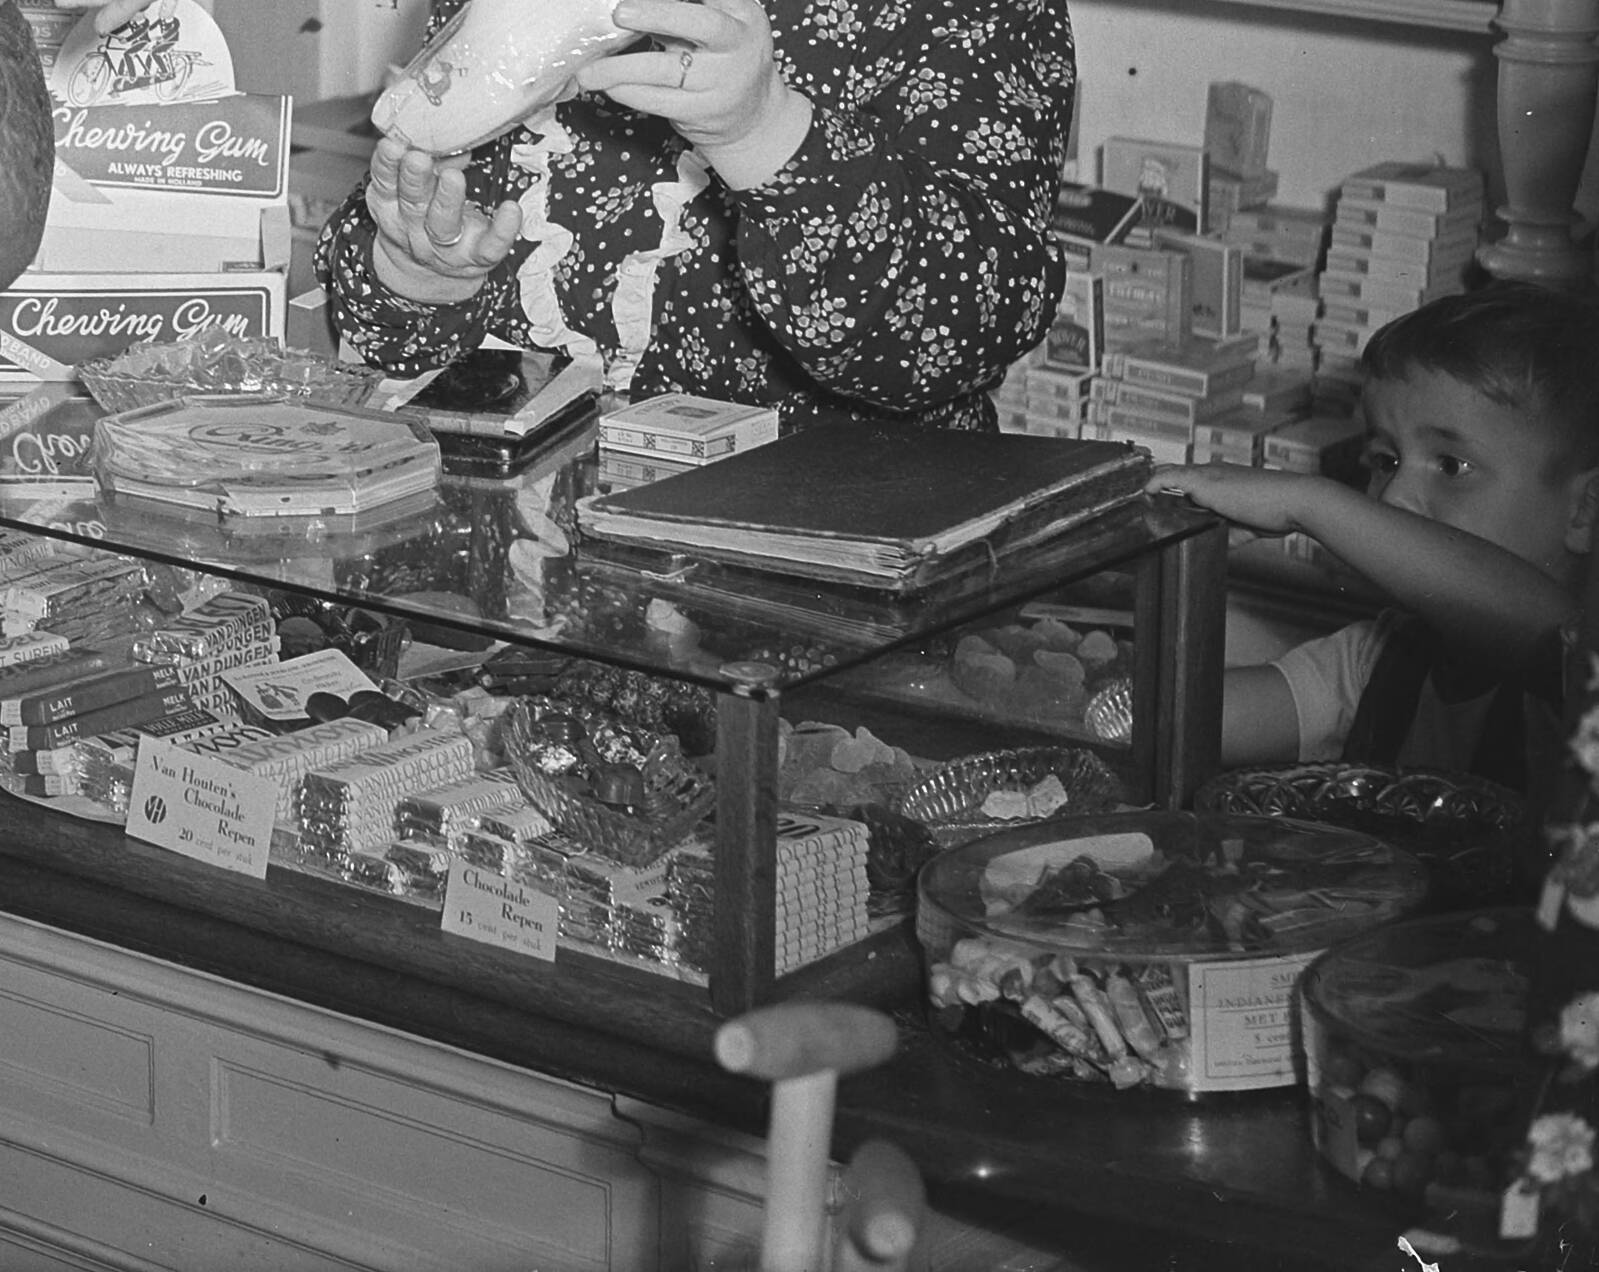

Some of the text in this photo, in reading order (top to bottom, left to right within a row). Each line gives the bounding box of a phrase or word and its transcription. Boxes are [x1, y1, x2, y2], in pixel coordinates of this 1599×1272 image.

[52, 107, 269, 166] Chewing Gum
[107, 161, 243, 183] ALWAYS REFRESHING
[11, 298, 249, 343] Chewing Gum
[9, 340, 51, 370] BAND
[203, 603, 267, 649] VAN DUNGEN
[153, 667, 175, 680] MELK
[183, 661, 211, 681] VAN
[213, 641, 274, 675] DUNGEN
[49, 697, 73, 713] LAIT
[163, 693, 186, 705] MELK
[54, 723, 79, 738] LAIT
[151, 754, 237, 800] Van Houten's
[183, 786, 246, 822] Chocolade
[178, 828, 194, 842] 20
[217, 819, 256, 847] Repen
[462, 869, 531, 907] Chocolade
[459, 909, 474, 926] 15
[501, 902, 544, 933] Repen
[1217, 994, 1289, 1009] INDIANE
